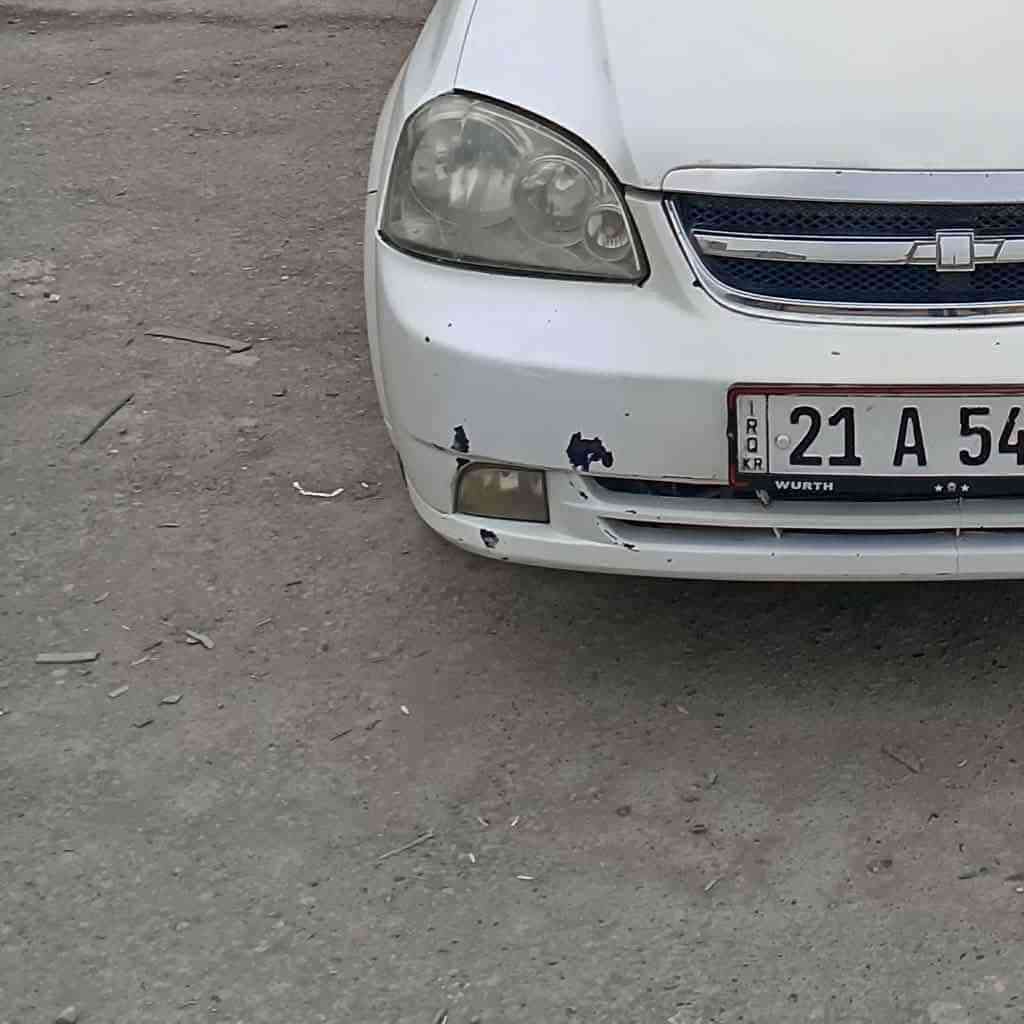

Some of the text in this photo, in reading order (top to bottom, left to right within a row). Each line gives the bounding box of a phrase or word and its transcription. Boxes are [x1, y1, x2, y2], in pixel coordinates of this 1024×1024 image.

[789, 406, 862, 467] 21
[892, 406, 928, 467] A
[743, 457, 763, 471] KR
[775, 480, 834, 491] WURTH
